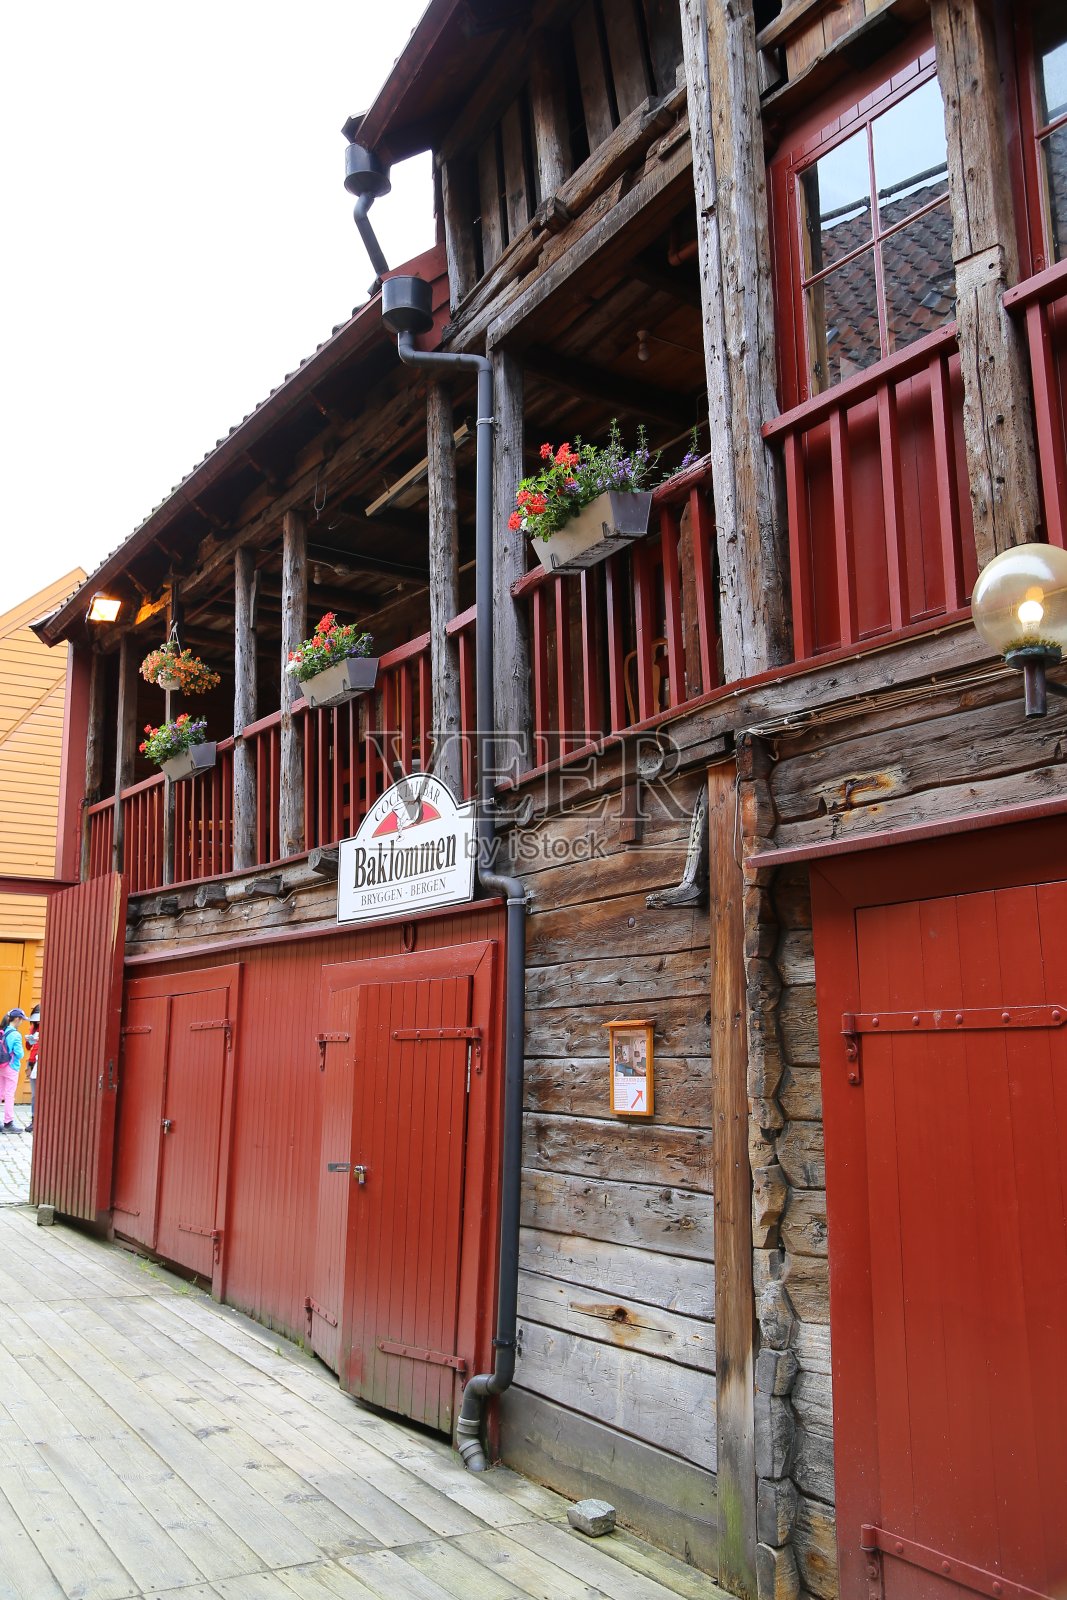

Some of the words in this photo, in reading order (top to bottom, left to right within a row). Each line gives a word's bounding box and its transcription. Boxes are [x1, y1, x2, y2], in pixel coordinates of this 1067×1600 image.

[353, 834, 457, 889] Baklommen
[361, 887, 403, 906] BRYGGEN
[410, 877, 447, 896] BERGEN
